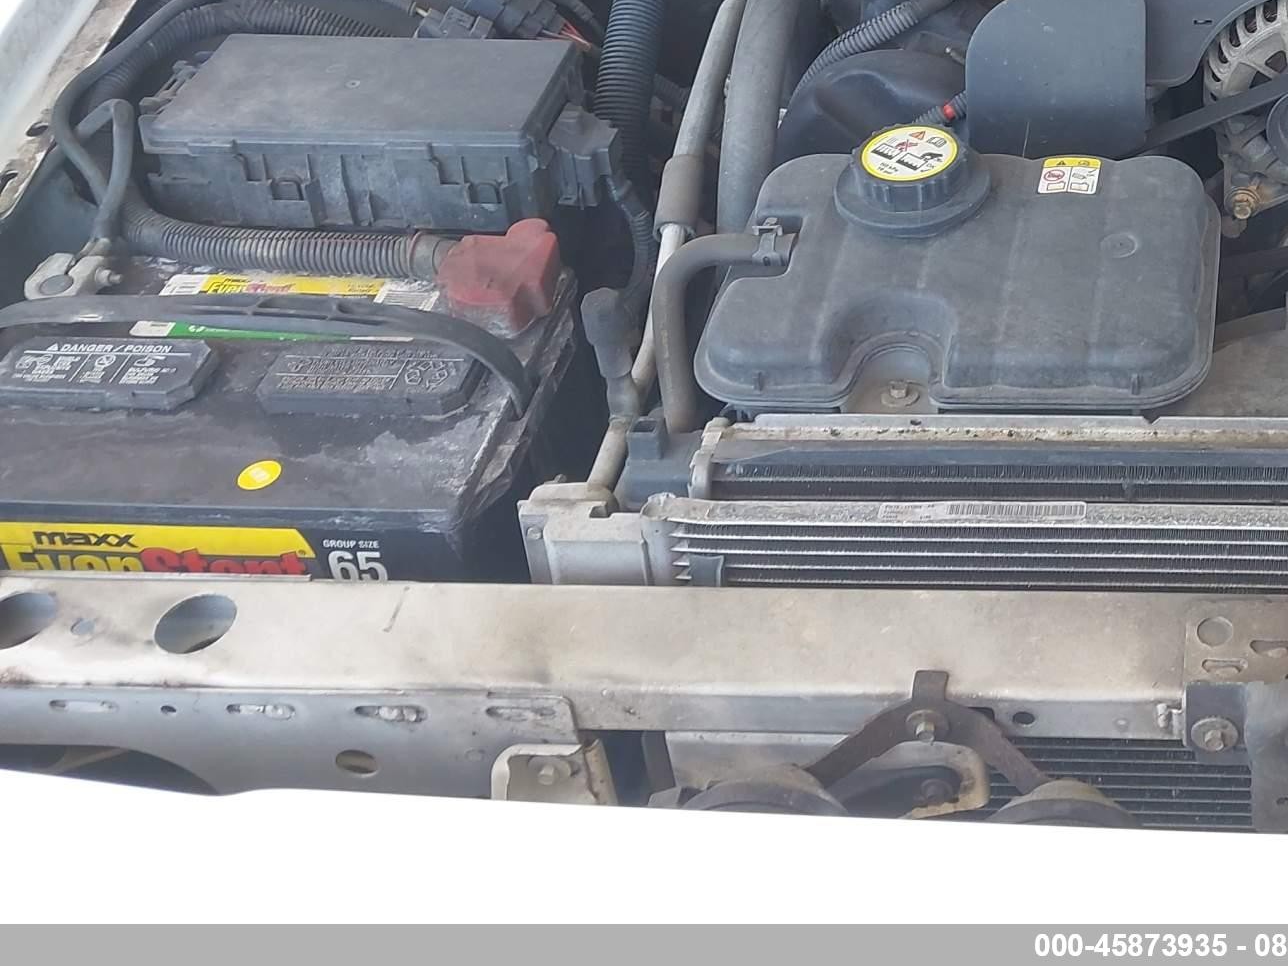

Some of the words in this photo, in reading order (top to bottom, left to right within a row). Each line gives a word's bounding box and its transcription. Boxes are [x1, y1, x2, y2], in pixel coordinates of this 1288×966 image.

[32, 531, 139, 548] maxx
[322, 539, 356, 548] GROUP
[358, 540, 380, 549] SIZE
[328, 550, 388, 581] 65
